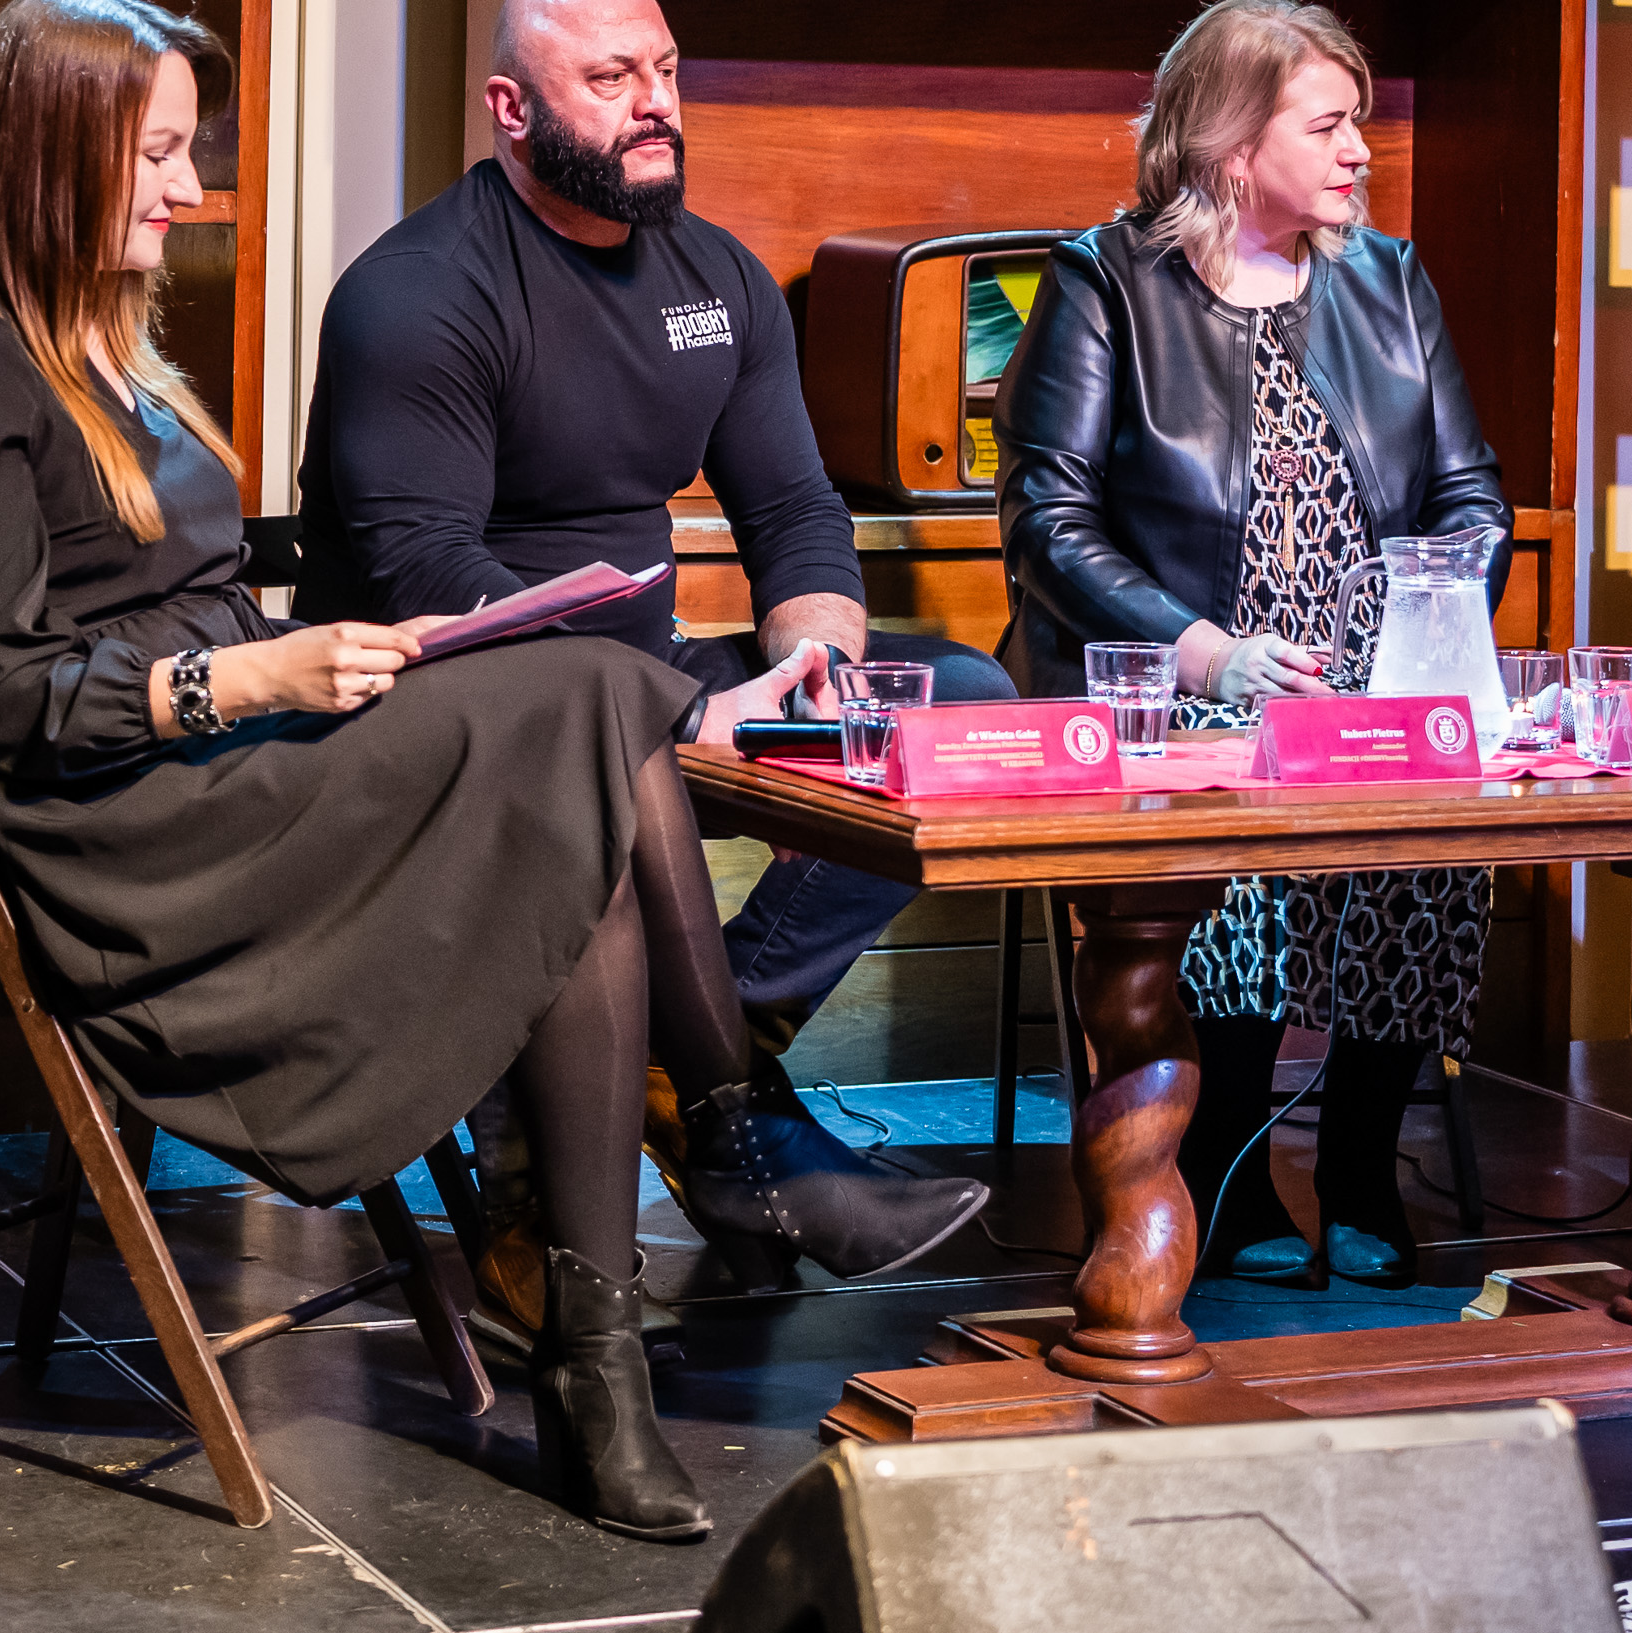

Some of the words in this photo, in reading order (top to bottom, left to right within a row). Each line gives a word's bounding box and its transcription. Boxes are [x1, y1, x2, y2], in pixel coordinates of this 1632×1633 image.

[661, 298, 723, 316] FUNDACJA
[666, 307, 730, 351] #DOBRY
[684, 332, 733, 348] hasztag
[966, 731, 978, 742] dr
[1340, 729, 1372, 739] Hubert
